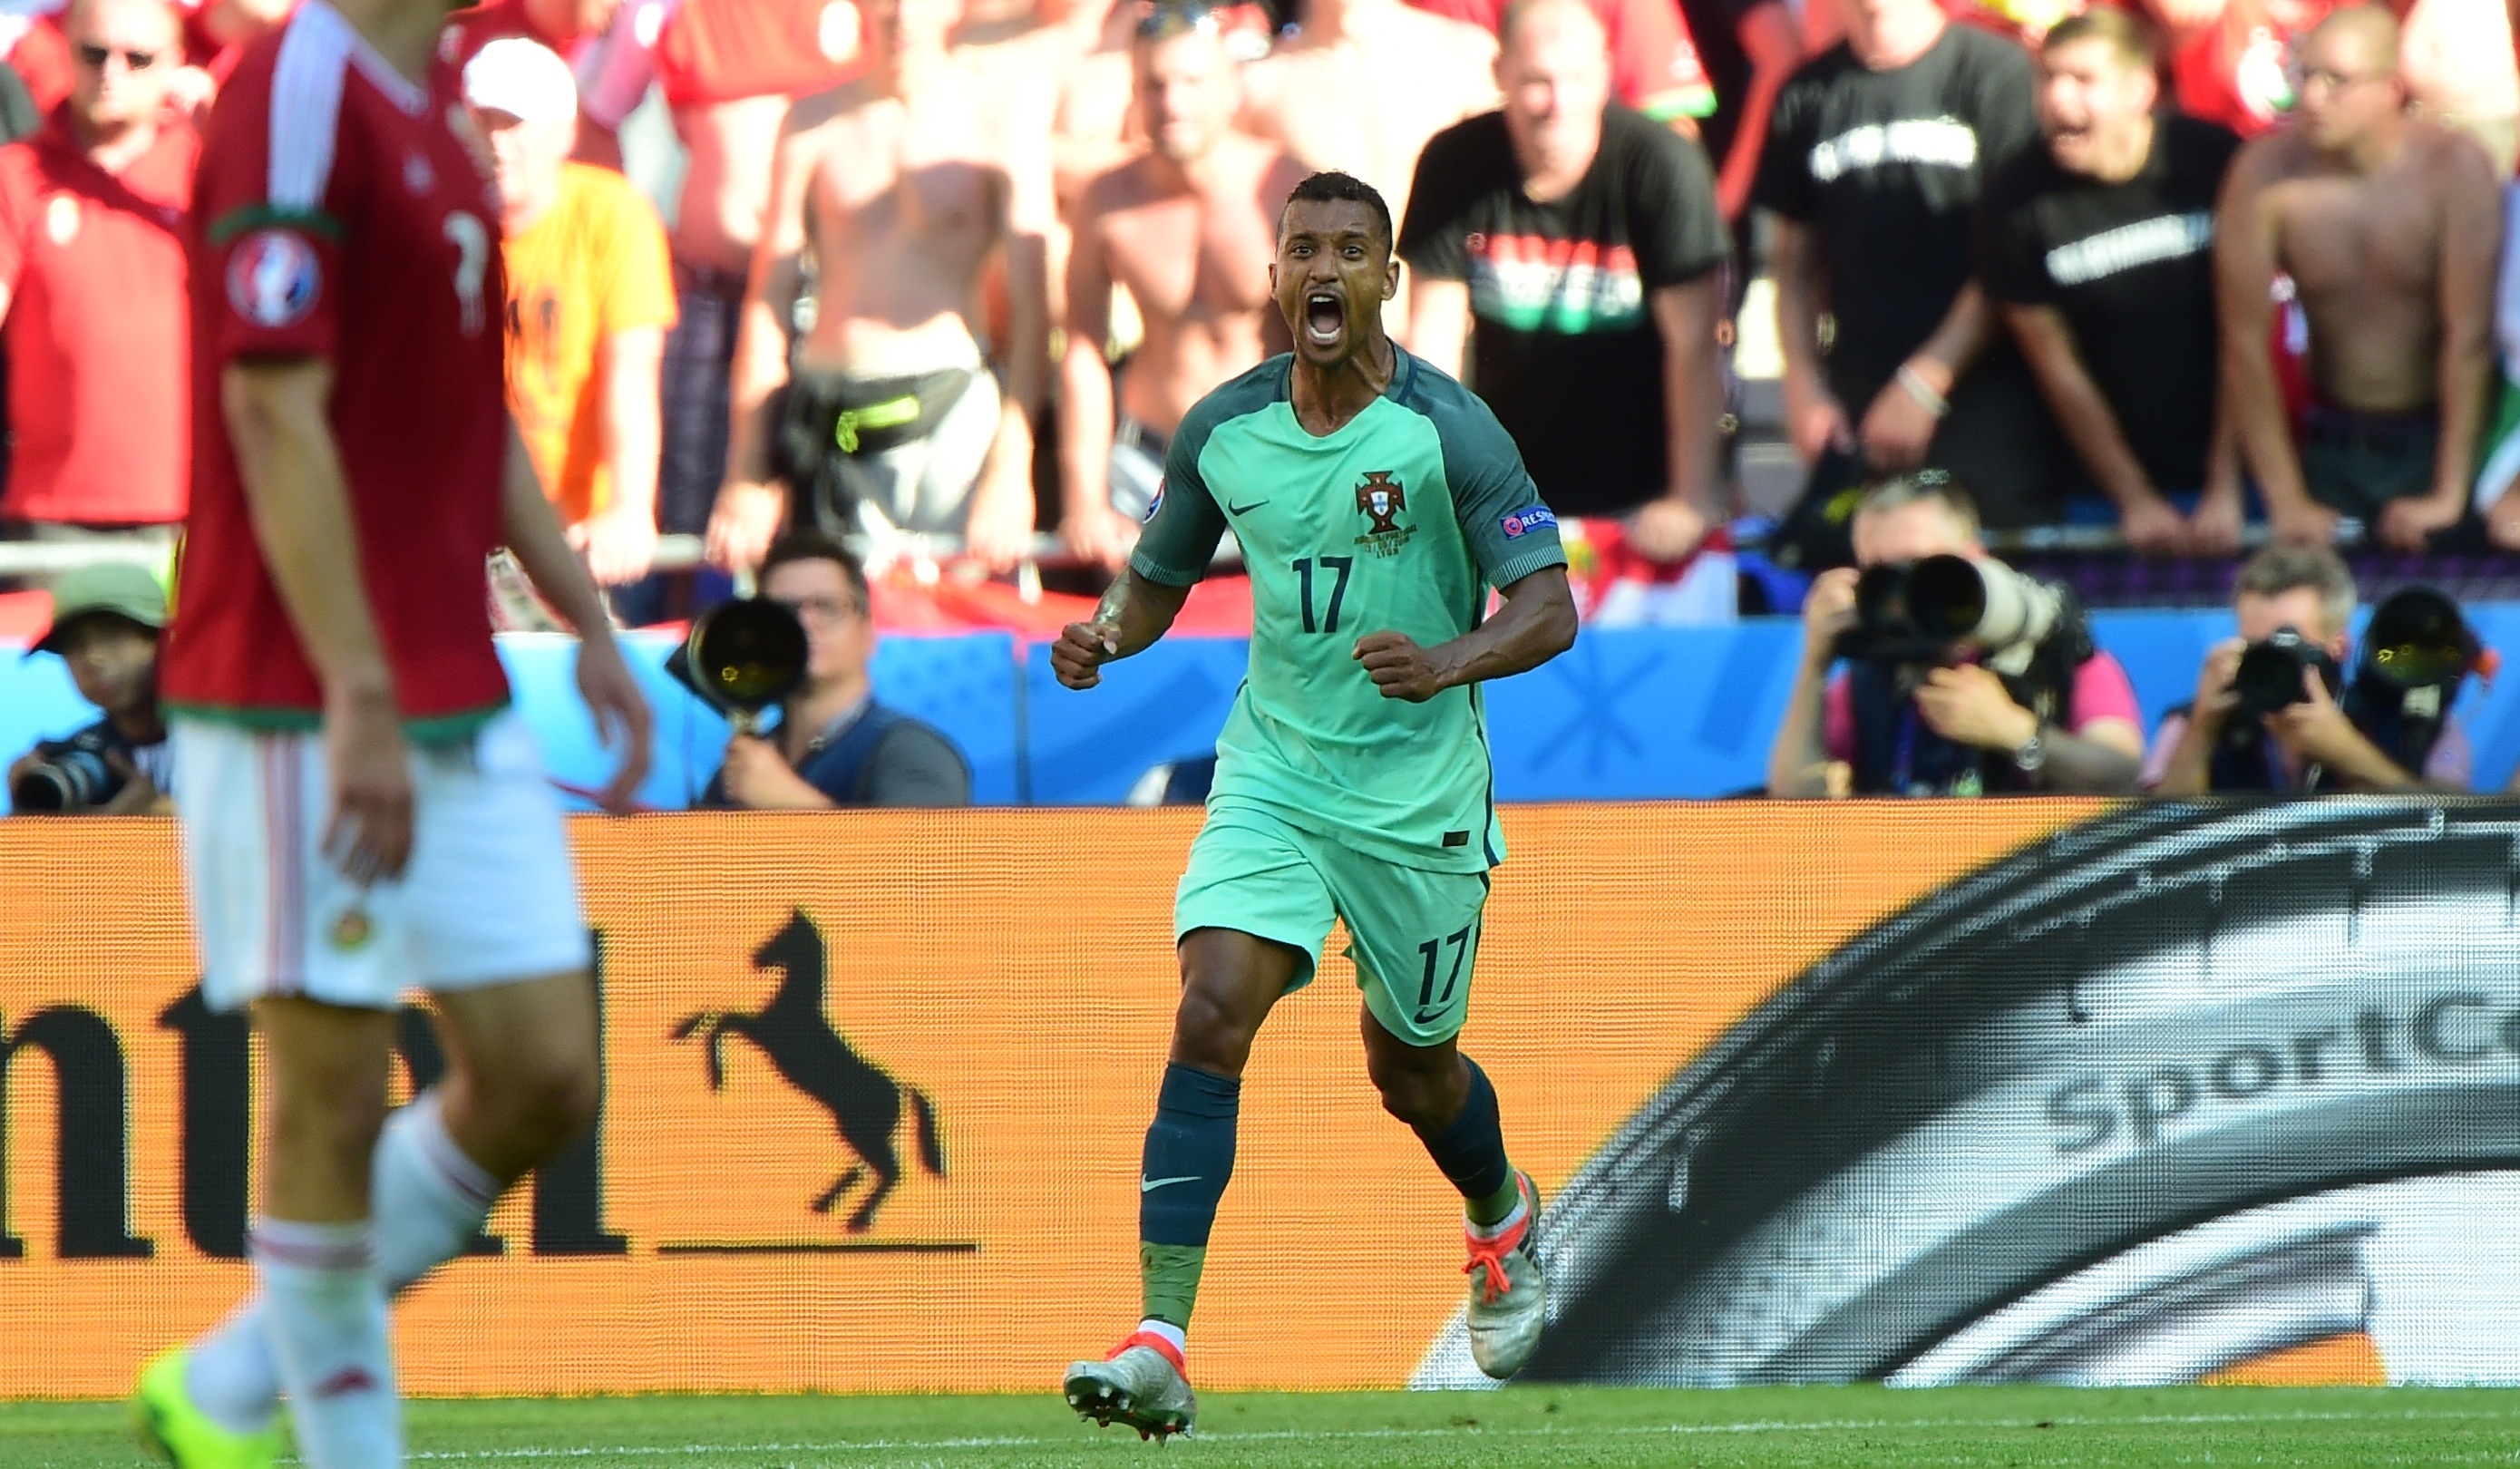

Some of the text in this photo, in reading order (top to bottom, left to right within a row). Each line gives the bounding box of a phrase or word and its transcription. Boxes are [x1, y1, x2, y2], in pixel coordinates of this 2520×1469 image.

[1292, 557, 1353, 634] 17
[1418, 923, 1471, 1006] 17
[2047, 991, 2520, 1153] SportC
